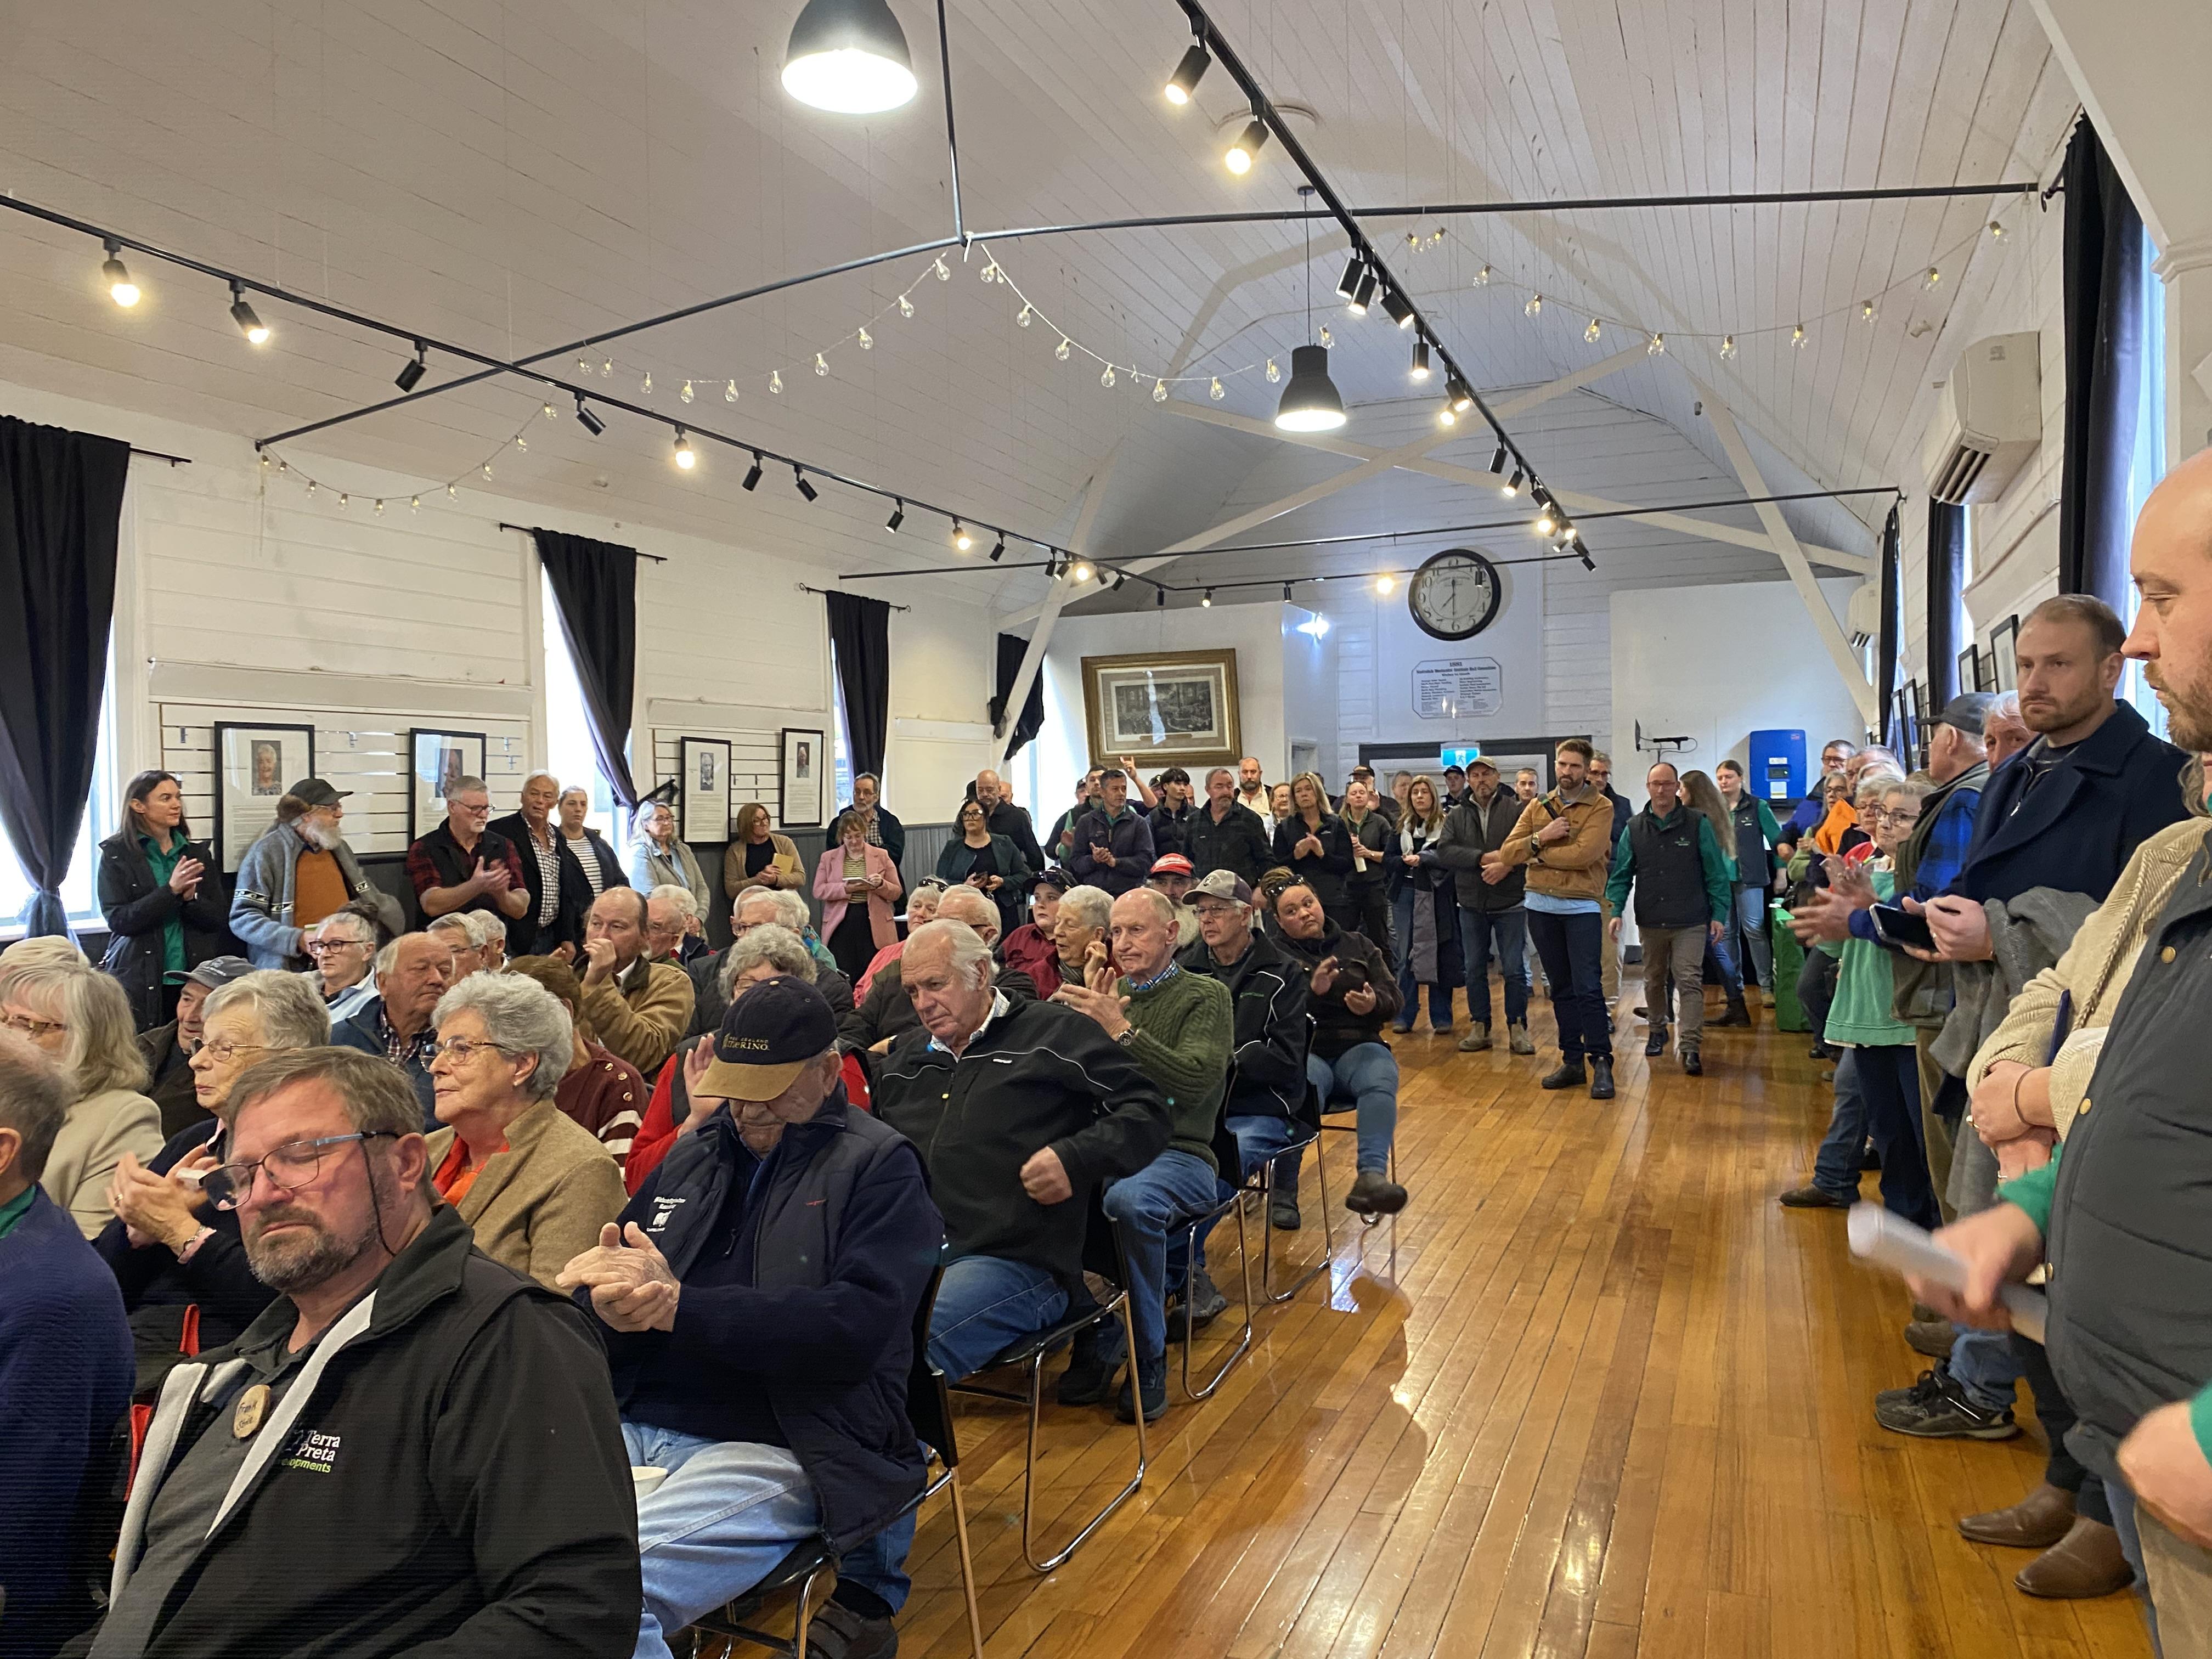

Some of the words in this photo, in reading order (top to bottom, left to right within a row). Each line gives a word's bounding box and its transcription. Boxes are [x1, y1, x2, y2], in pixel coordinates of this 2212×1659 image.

[1422, 577, 1432, 588] 10
[1418, 592, 1426, 603] 9
[1477, 602, 1486, 613] 4
[1436, 619, 1443, 629] 7
[1468, 614, 1476, 625] 5
[1452, 620, 1460, 631] 6
[304, 1430, 340, 1447] Terra
[296, 1443, 336, 1462] Preta
